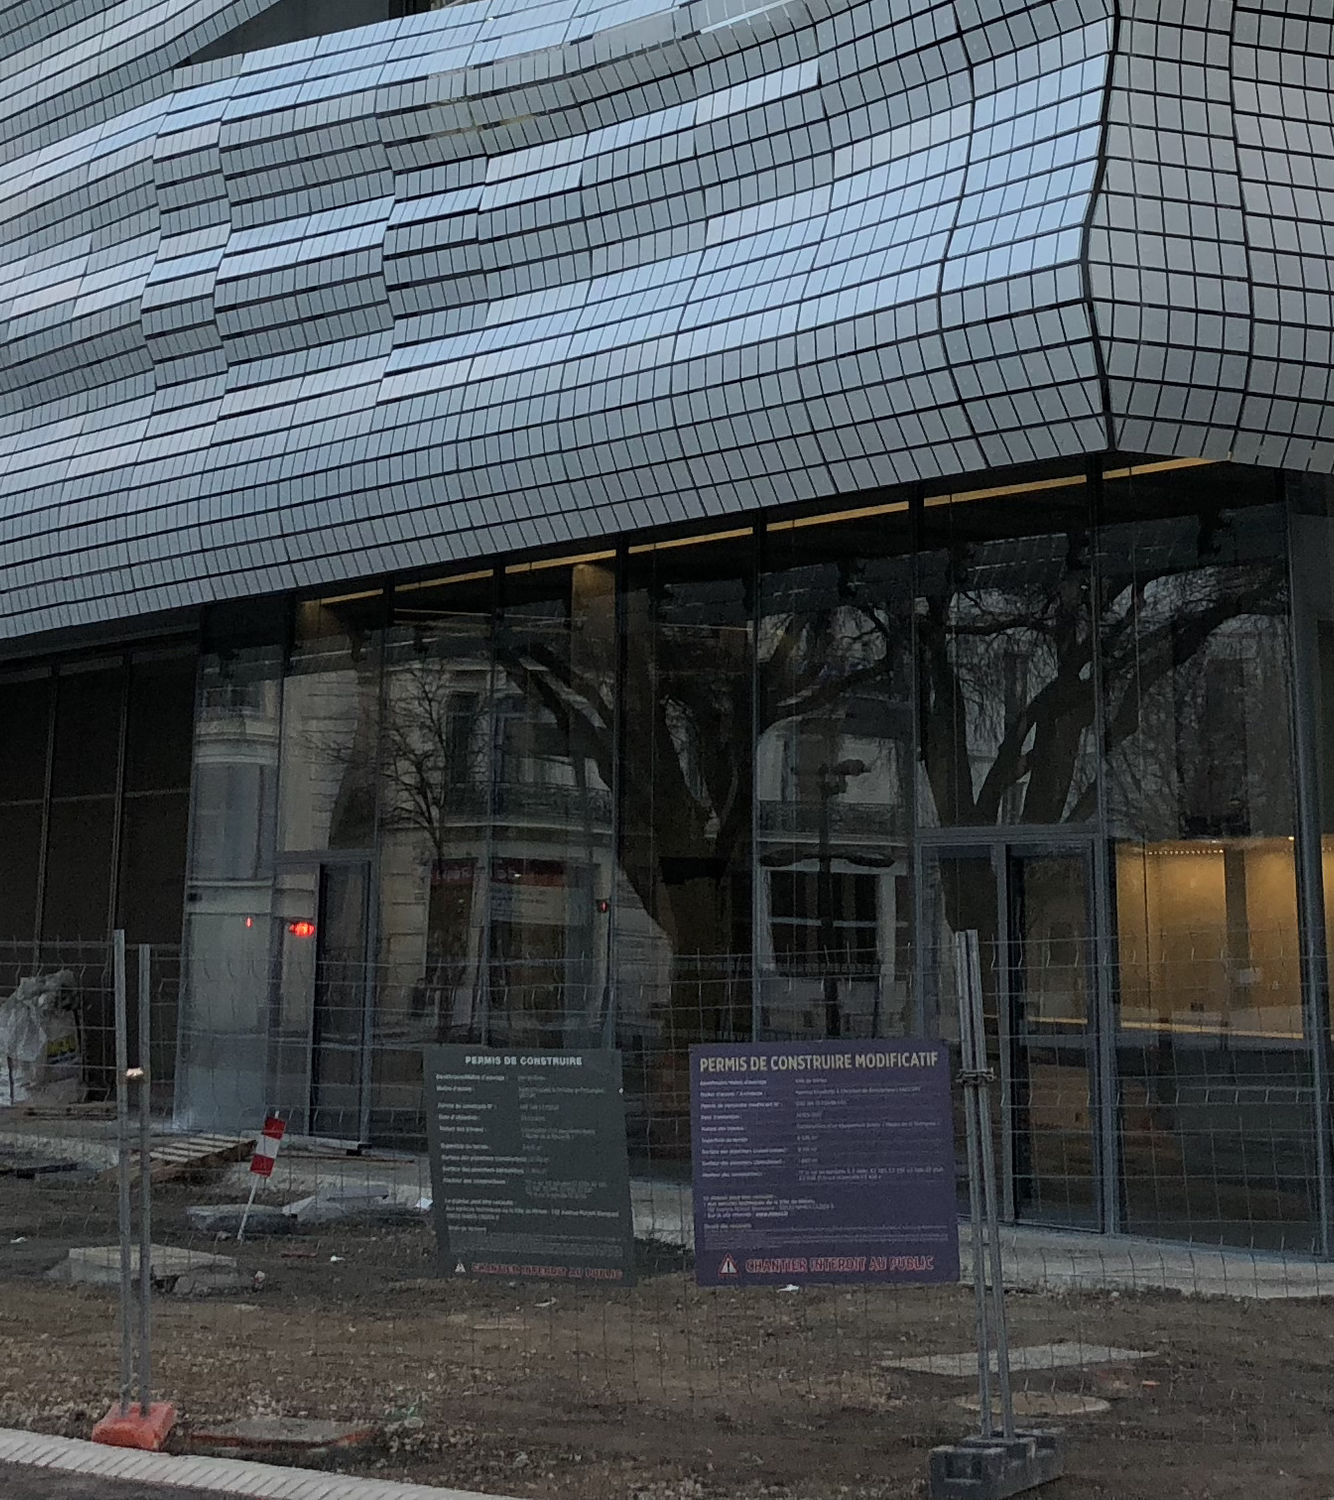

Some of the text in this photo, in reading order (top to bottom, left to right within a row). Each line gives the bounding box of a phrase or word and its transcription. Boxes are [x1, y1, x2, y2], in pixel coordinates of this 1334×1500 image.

[465, 1056, 583, 1066] PERMIS DE CONSTRUIRE
[700, 1052, 939, 1072] PERMIS DE CONSTRUIRE MODIFICATIF
[746, 1256, 934, 1273] CHANTIER INTERDIT AU PUBLIC
